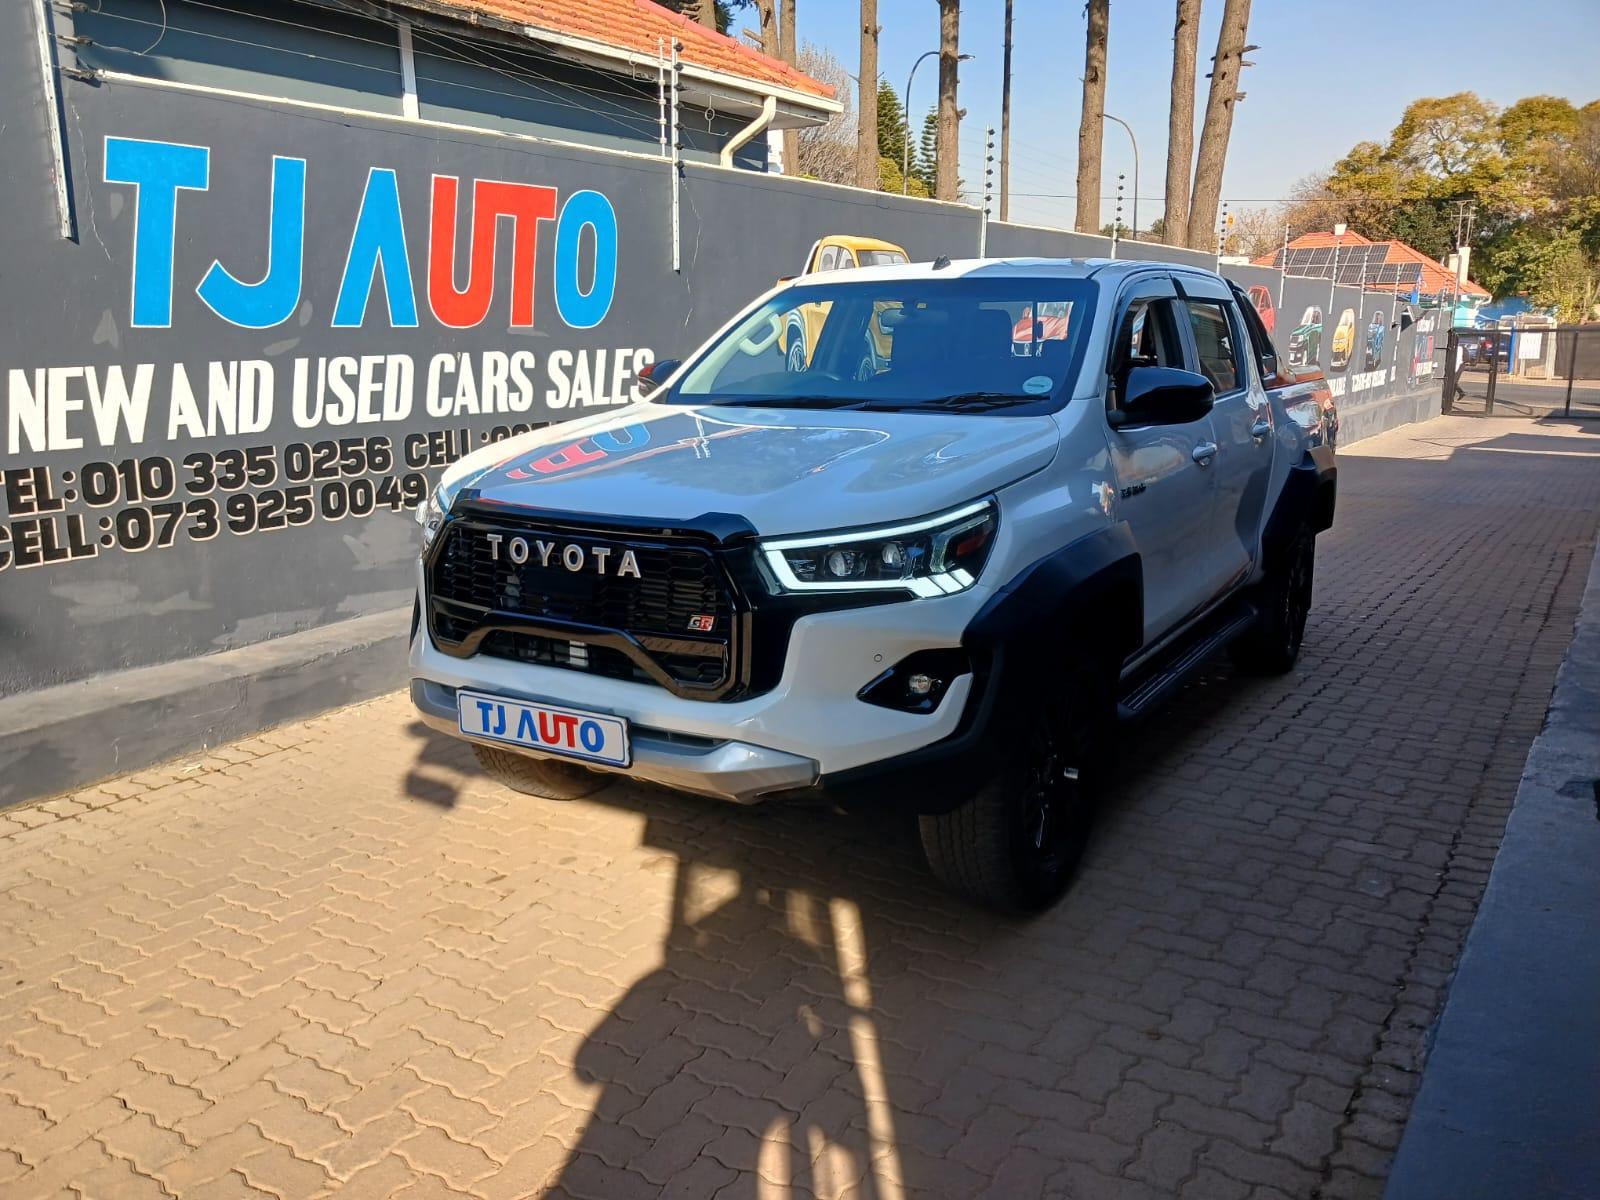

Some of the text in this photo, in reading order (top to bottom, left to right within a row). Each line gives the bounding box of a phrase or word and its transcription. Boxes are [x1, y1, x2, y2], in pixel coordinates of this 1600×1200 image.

[103, 135, 618, 329] TJ AUTO
[8, 348, 655, 454] NEW AND USED CARS SALES
[0, 456, 175, 518] EL:010
[183, 446, 277, 496] 335
[284, 436, 393, 485] 0256
[227, 485, 315, 534] 925
[321, 472, 429, 519] 0049
[486, 533, 642, 578] TOYOTA
[687, 614, 715, 632] GR
[476, 701, 605, 753] TJ AUTO
